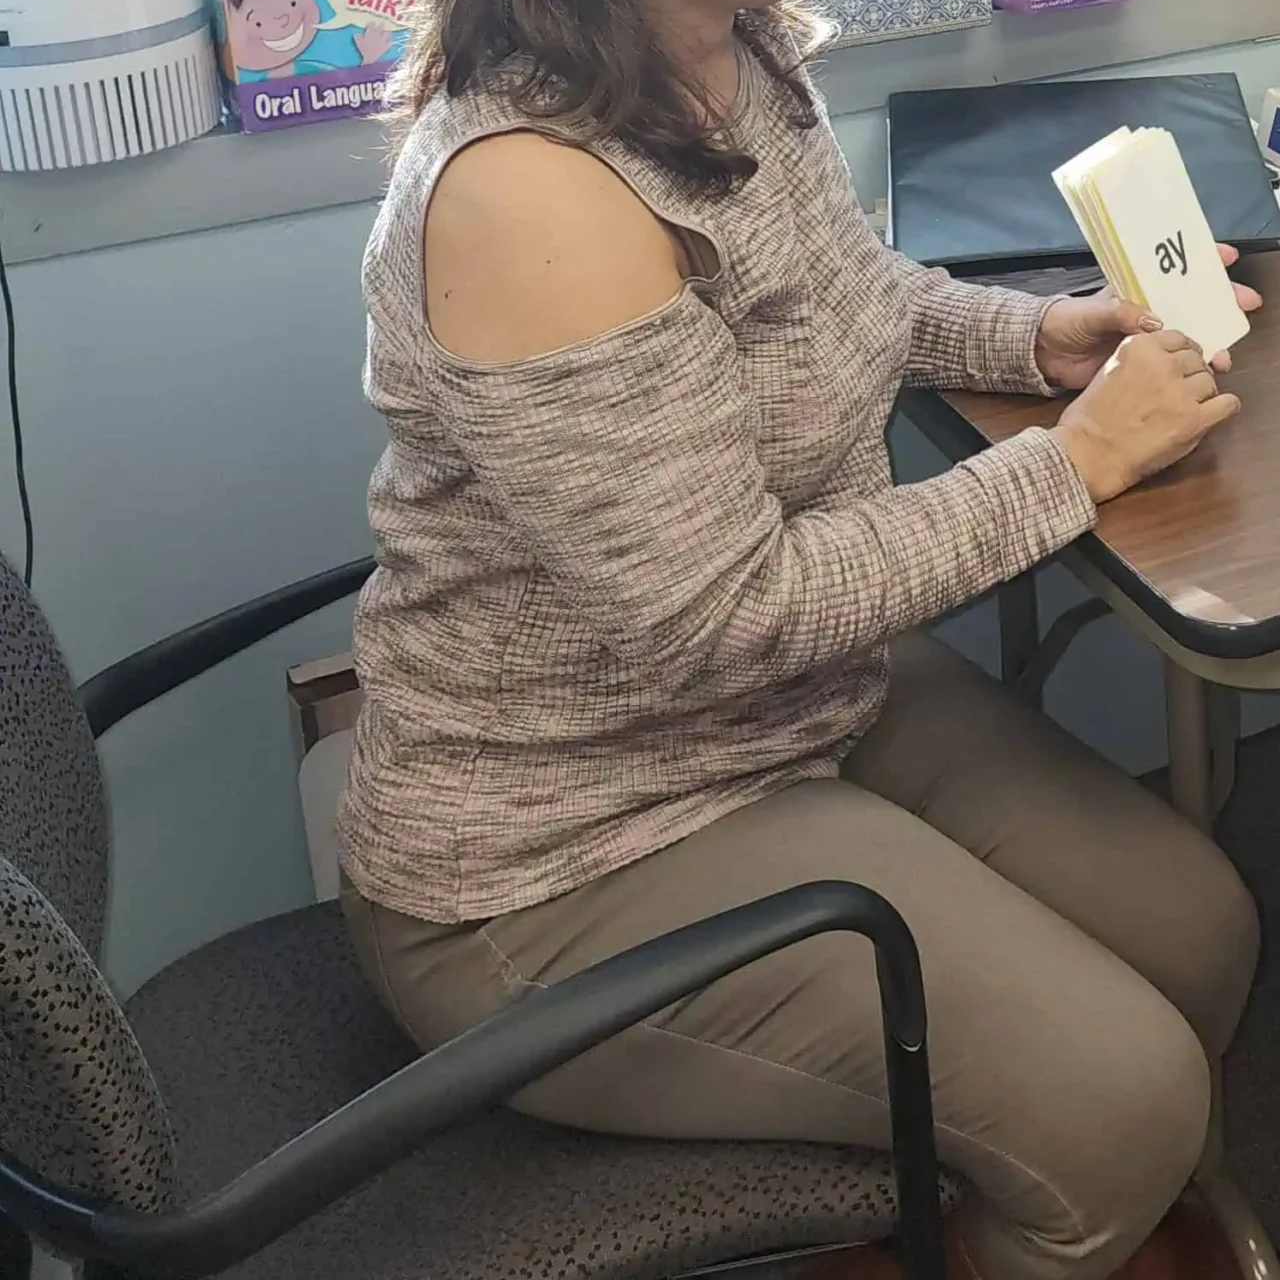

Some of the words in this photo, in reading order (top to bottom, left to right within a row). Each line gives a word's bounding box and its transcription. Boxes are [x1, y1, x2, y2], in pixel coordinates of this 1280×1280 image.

[255, 88, 302, 119] Oral
[310, 80, 388, 110] Langua
[1154, 230, 1188, 276] ay
